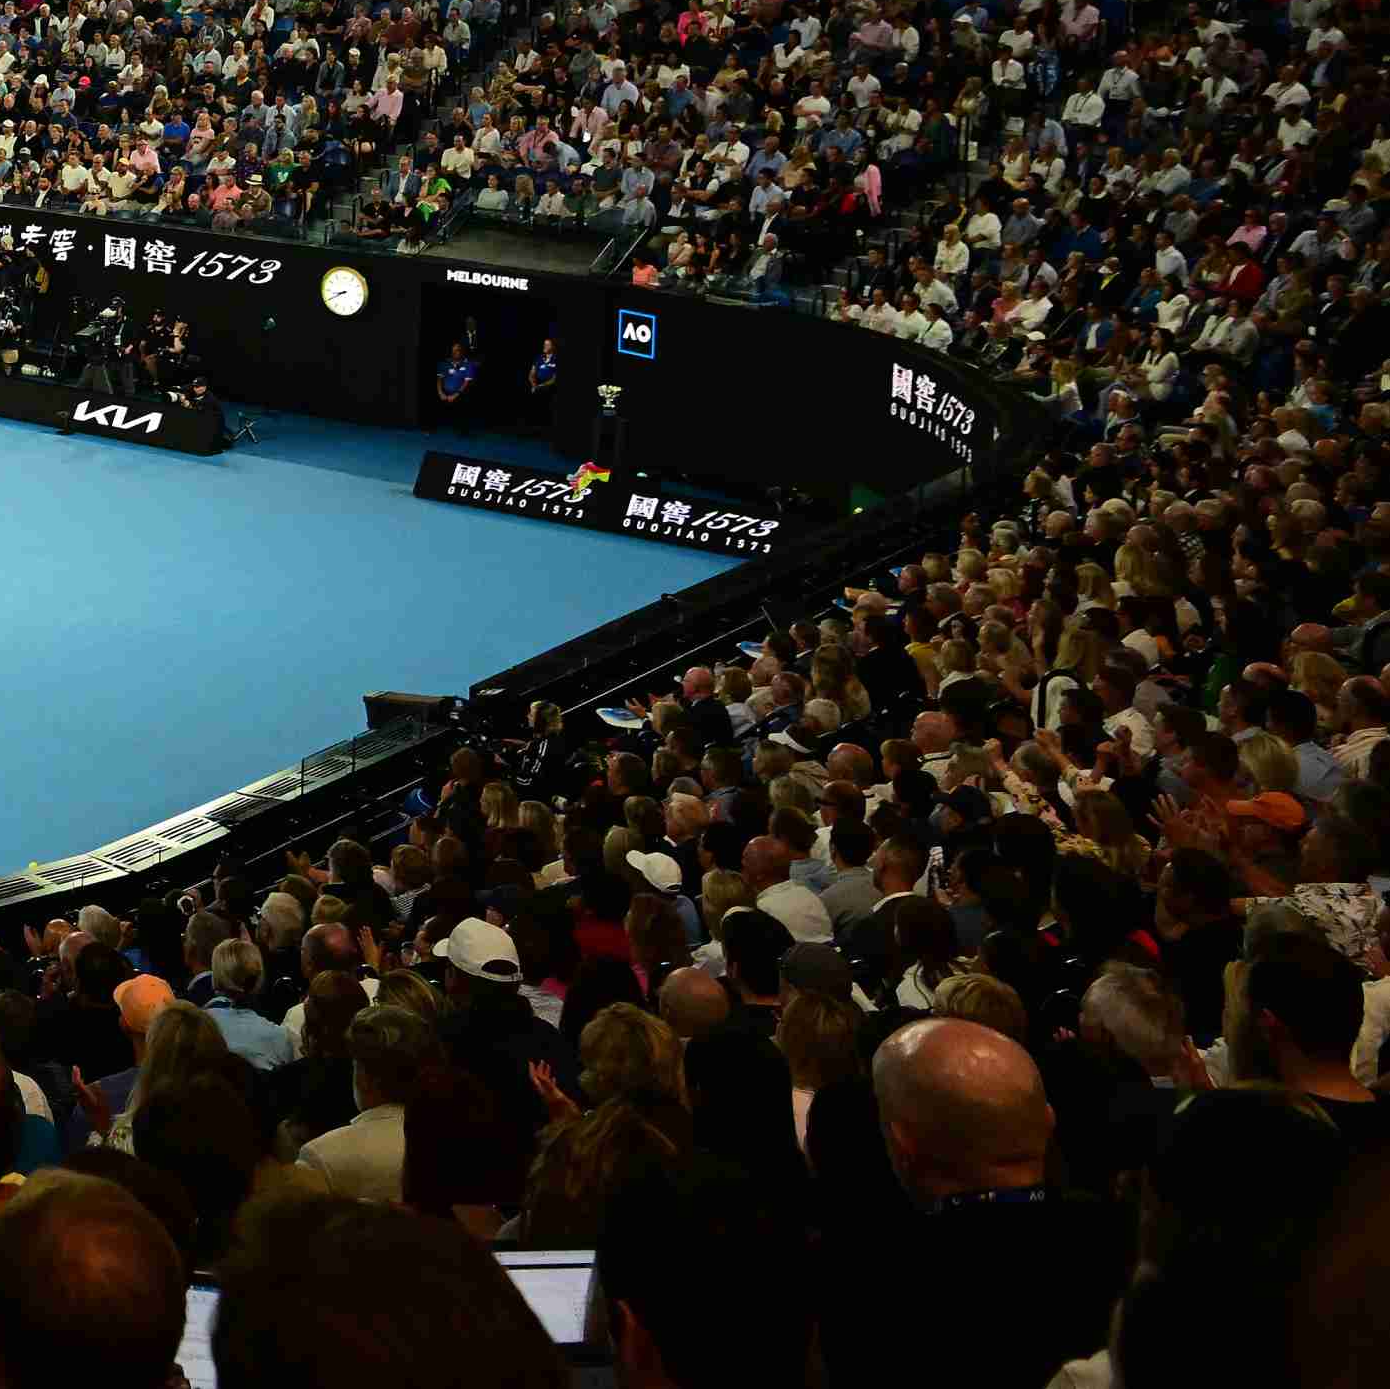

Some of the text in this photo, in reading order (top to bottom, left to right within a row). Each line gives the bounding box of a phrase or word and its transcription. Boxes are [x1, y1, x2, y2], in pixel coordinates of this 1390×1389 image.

[447, 270, 528, 290] MELBOURNE
[623, 323, 653, 345] AO
[73, 401, 162, 433] KIA
[447, 486, 583, 519] GUOJIAO 1573
[622, 518, 771, 553] GUOJIAO 1573
